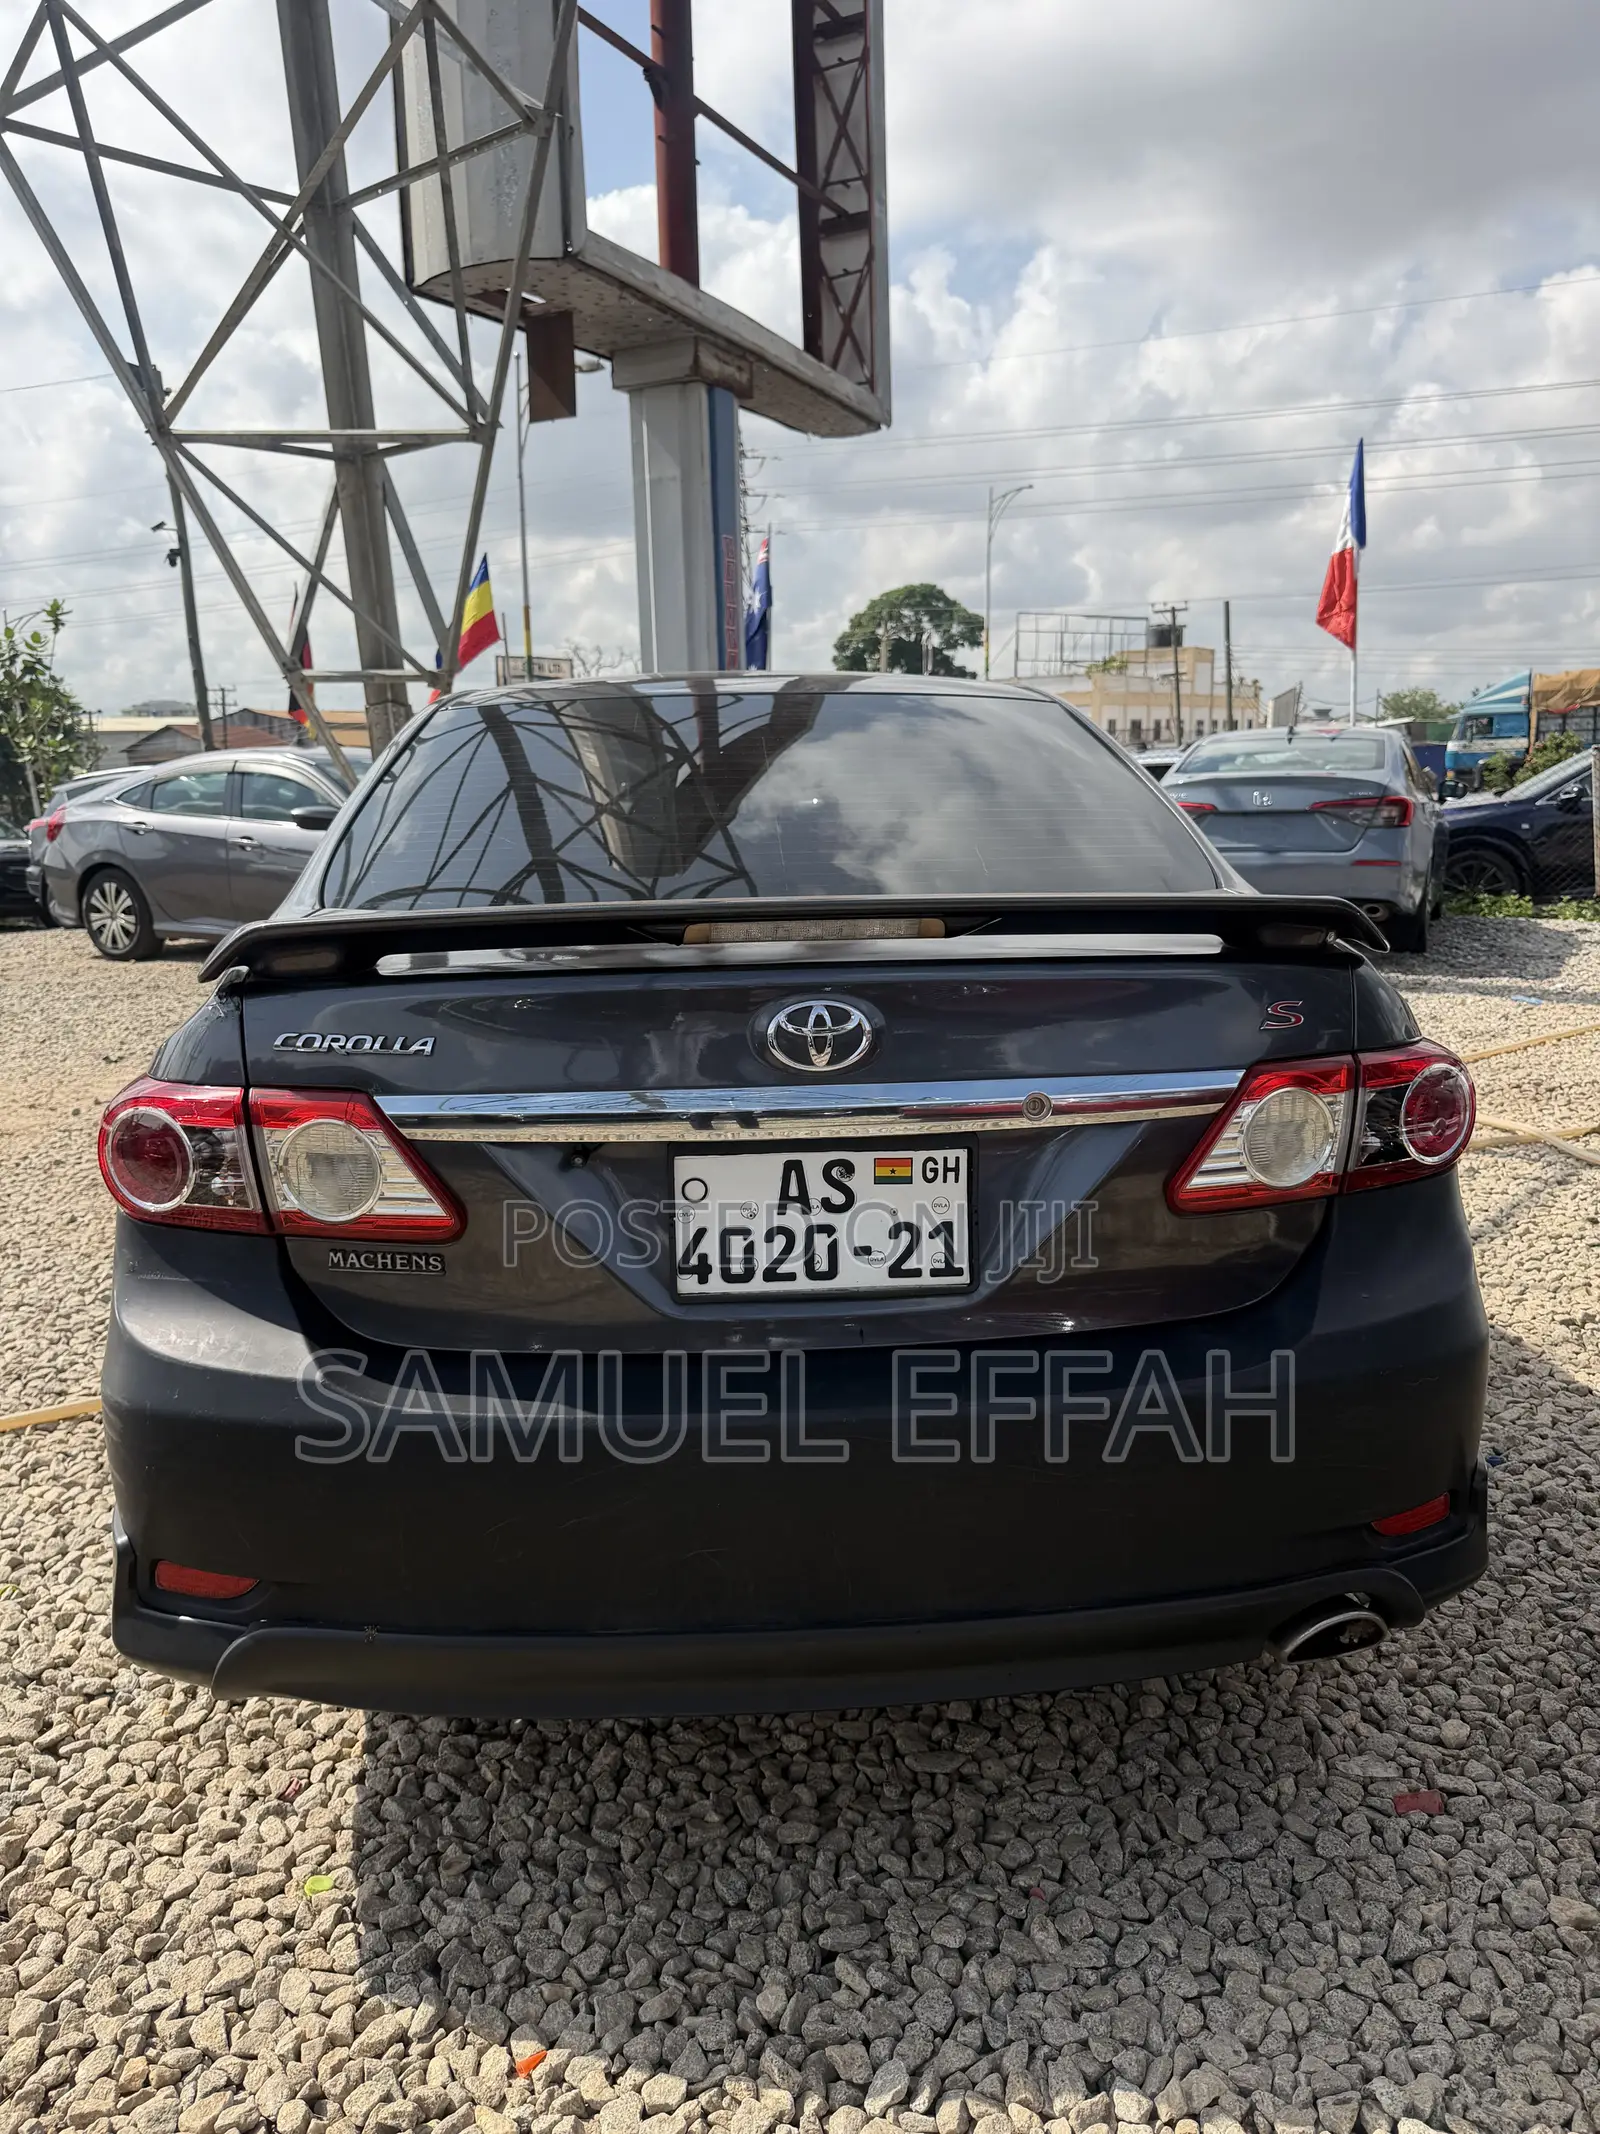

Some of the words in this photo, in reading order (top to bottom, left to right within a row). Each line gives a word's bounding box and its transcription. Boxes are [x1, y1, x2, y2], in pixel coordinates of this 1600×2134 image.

[1260, 1000, 1304, 1030] S
[273, 1033, 436, 1056] COROLLA
[777, 1159, 855, 1216] AS
[921, 1156, 960, 1184] GH
[328, 1251, 443, 1271] MACHENS
